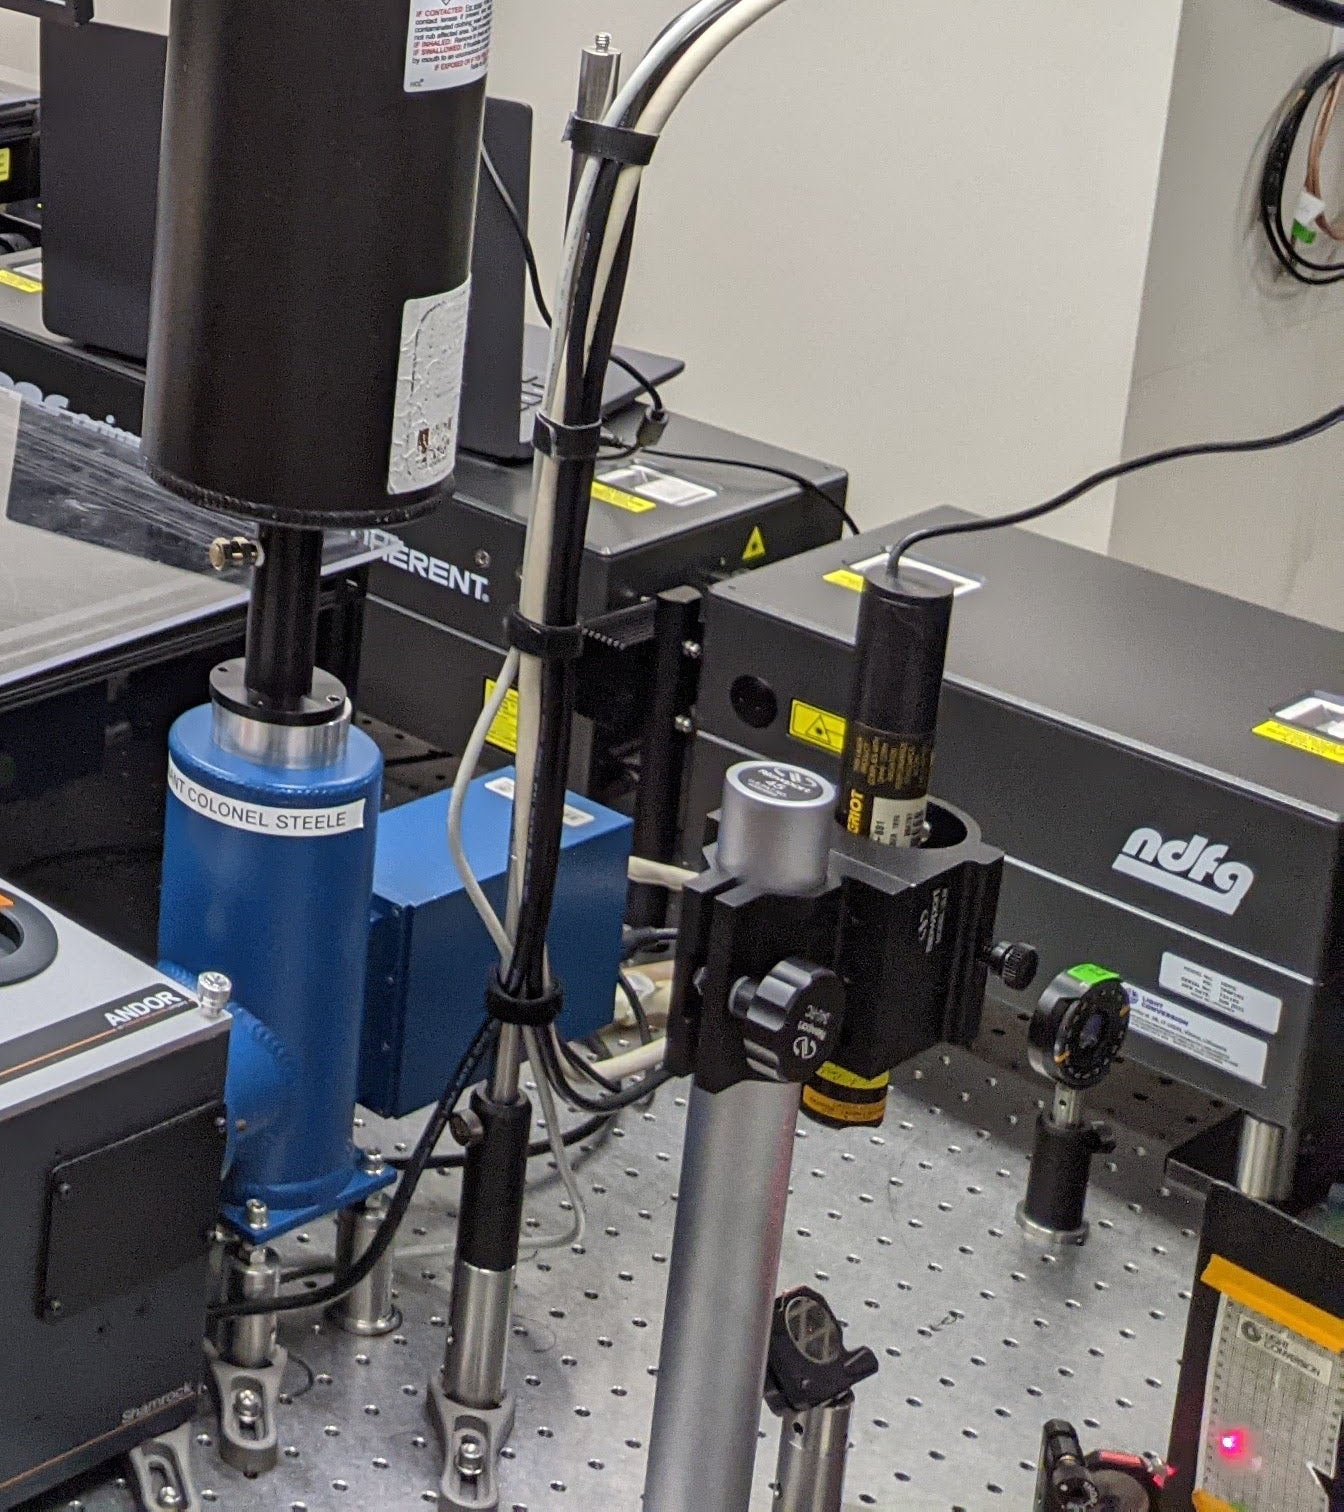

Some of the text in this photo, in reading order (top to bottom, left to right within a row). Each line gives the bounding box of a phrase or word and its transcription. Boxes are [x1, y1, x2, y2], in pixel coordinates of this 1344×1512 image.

[188, 787, 268, 828] COLONEL
[275, 811, 348, 831] STEELE
[104, 991, 182, 1027] ANDOR
